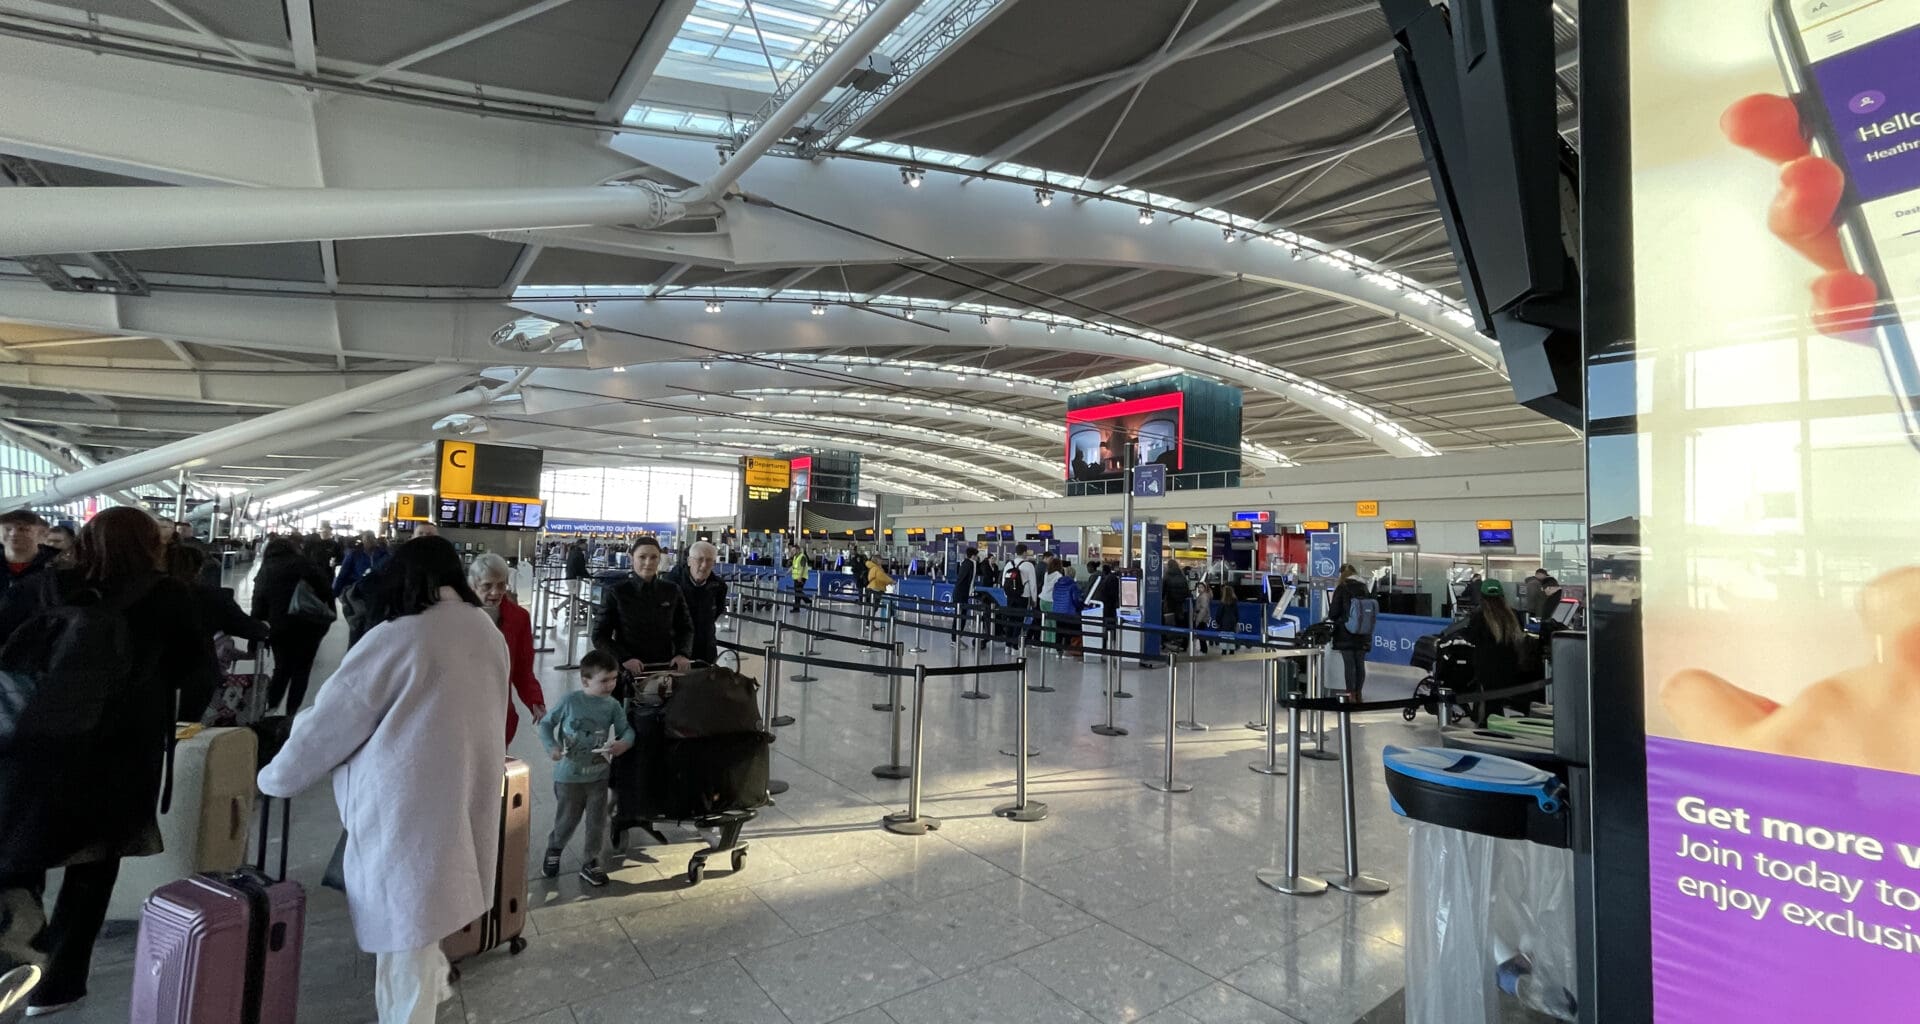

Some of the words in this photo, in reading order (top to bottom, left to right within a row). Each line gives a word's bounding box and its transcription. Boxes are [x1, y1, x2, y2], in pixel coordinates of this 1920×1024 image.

[450, 449, 468, 468] C
[402, 496, 410, 505] B
[574, 523, 605, 532] welcome
[1374, 635, 1397, 651] Bag
[1676, 796, 1751, 835] Get
[1761, 817, 1884, 861] more
[1676, 834, 1743, 871] Join
[1753, 852, 1863, 903] today
[1875, 879, 1920, 911] to
[1678, 875, 1771, 921] enjoy
